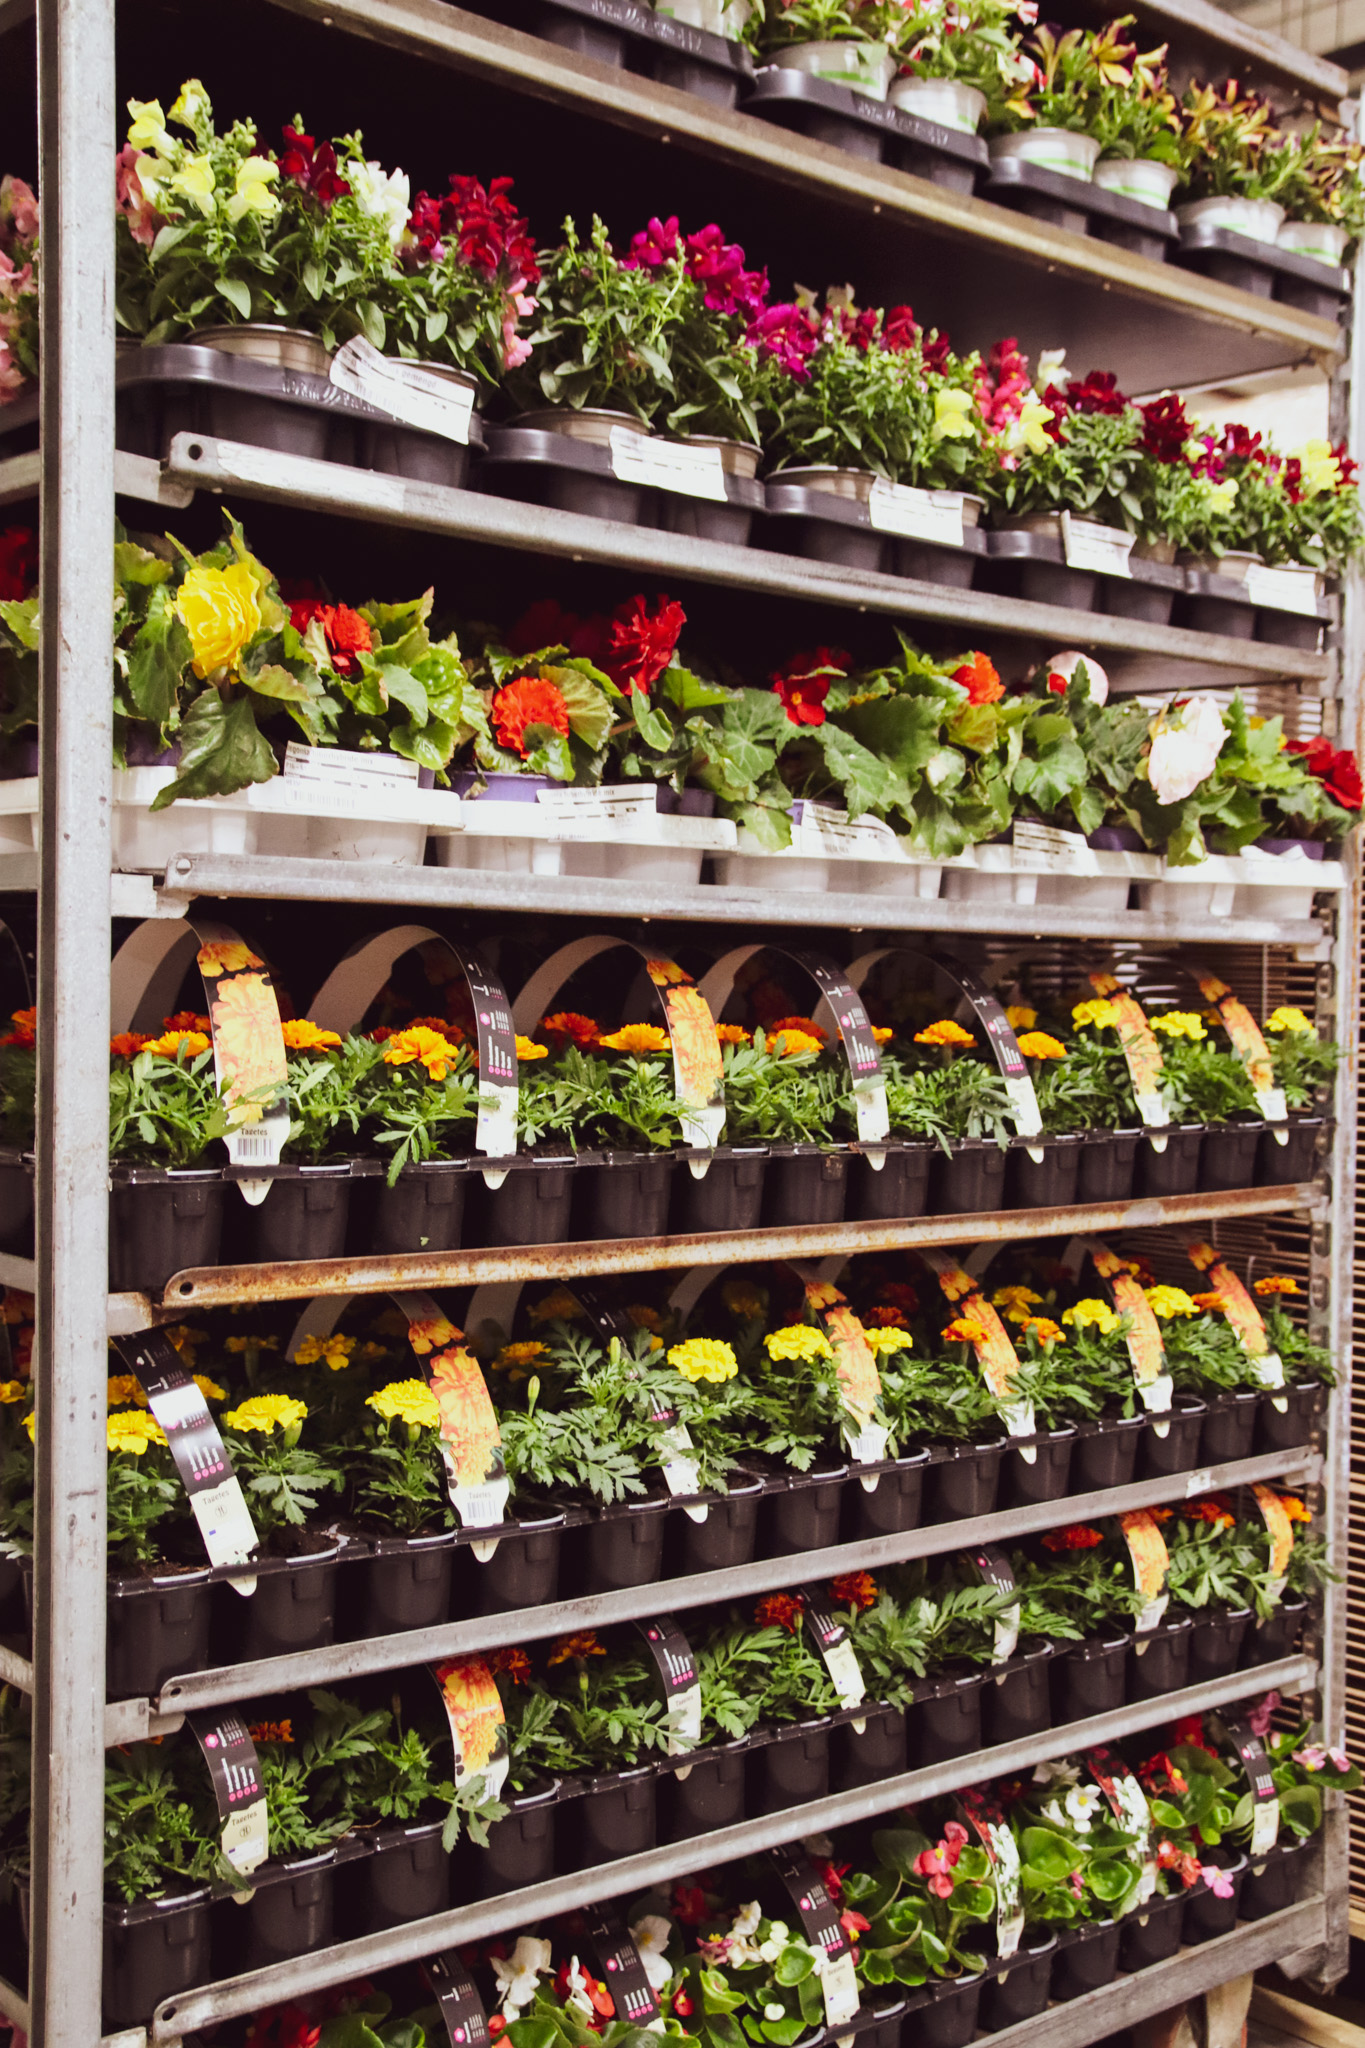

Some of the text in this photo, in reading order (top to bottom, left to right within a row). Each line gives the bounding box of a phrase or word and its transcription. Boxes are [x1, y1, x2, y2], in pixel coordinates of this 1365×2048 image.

[241, 1128, 268, 1136] Tagetes
[203, 1489, 230, 1505] Tagetes
[231, 1811, 258, 1826] Tagetes
